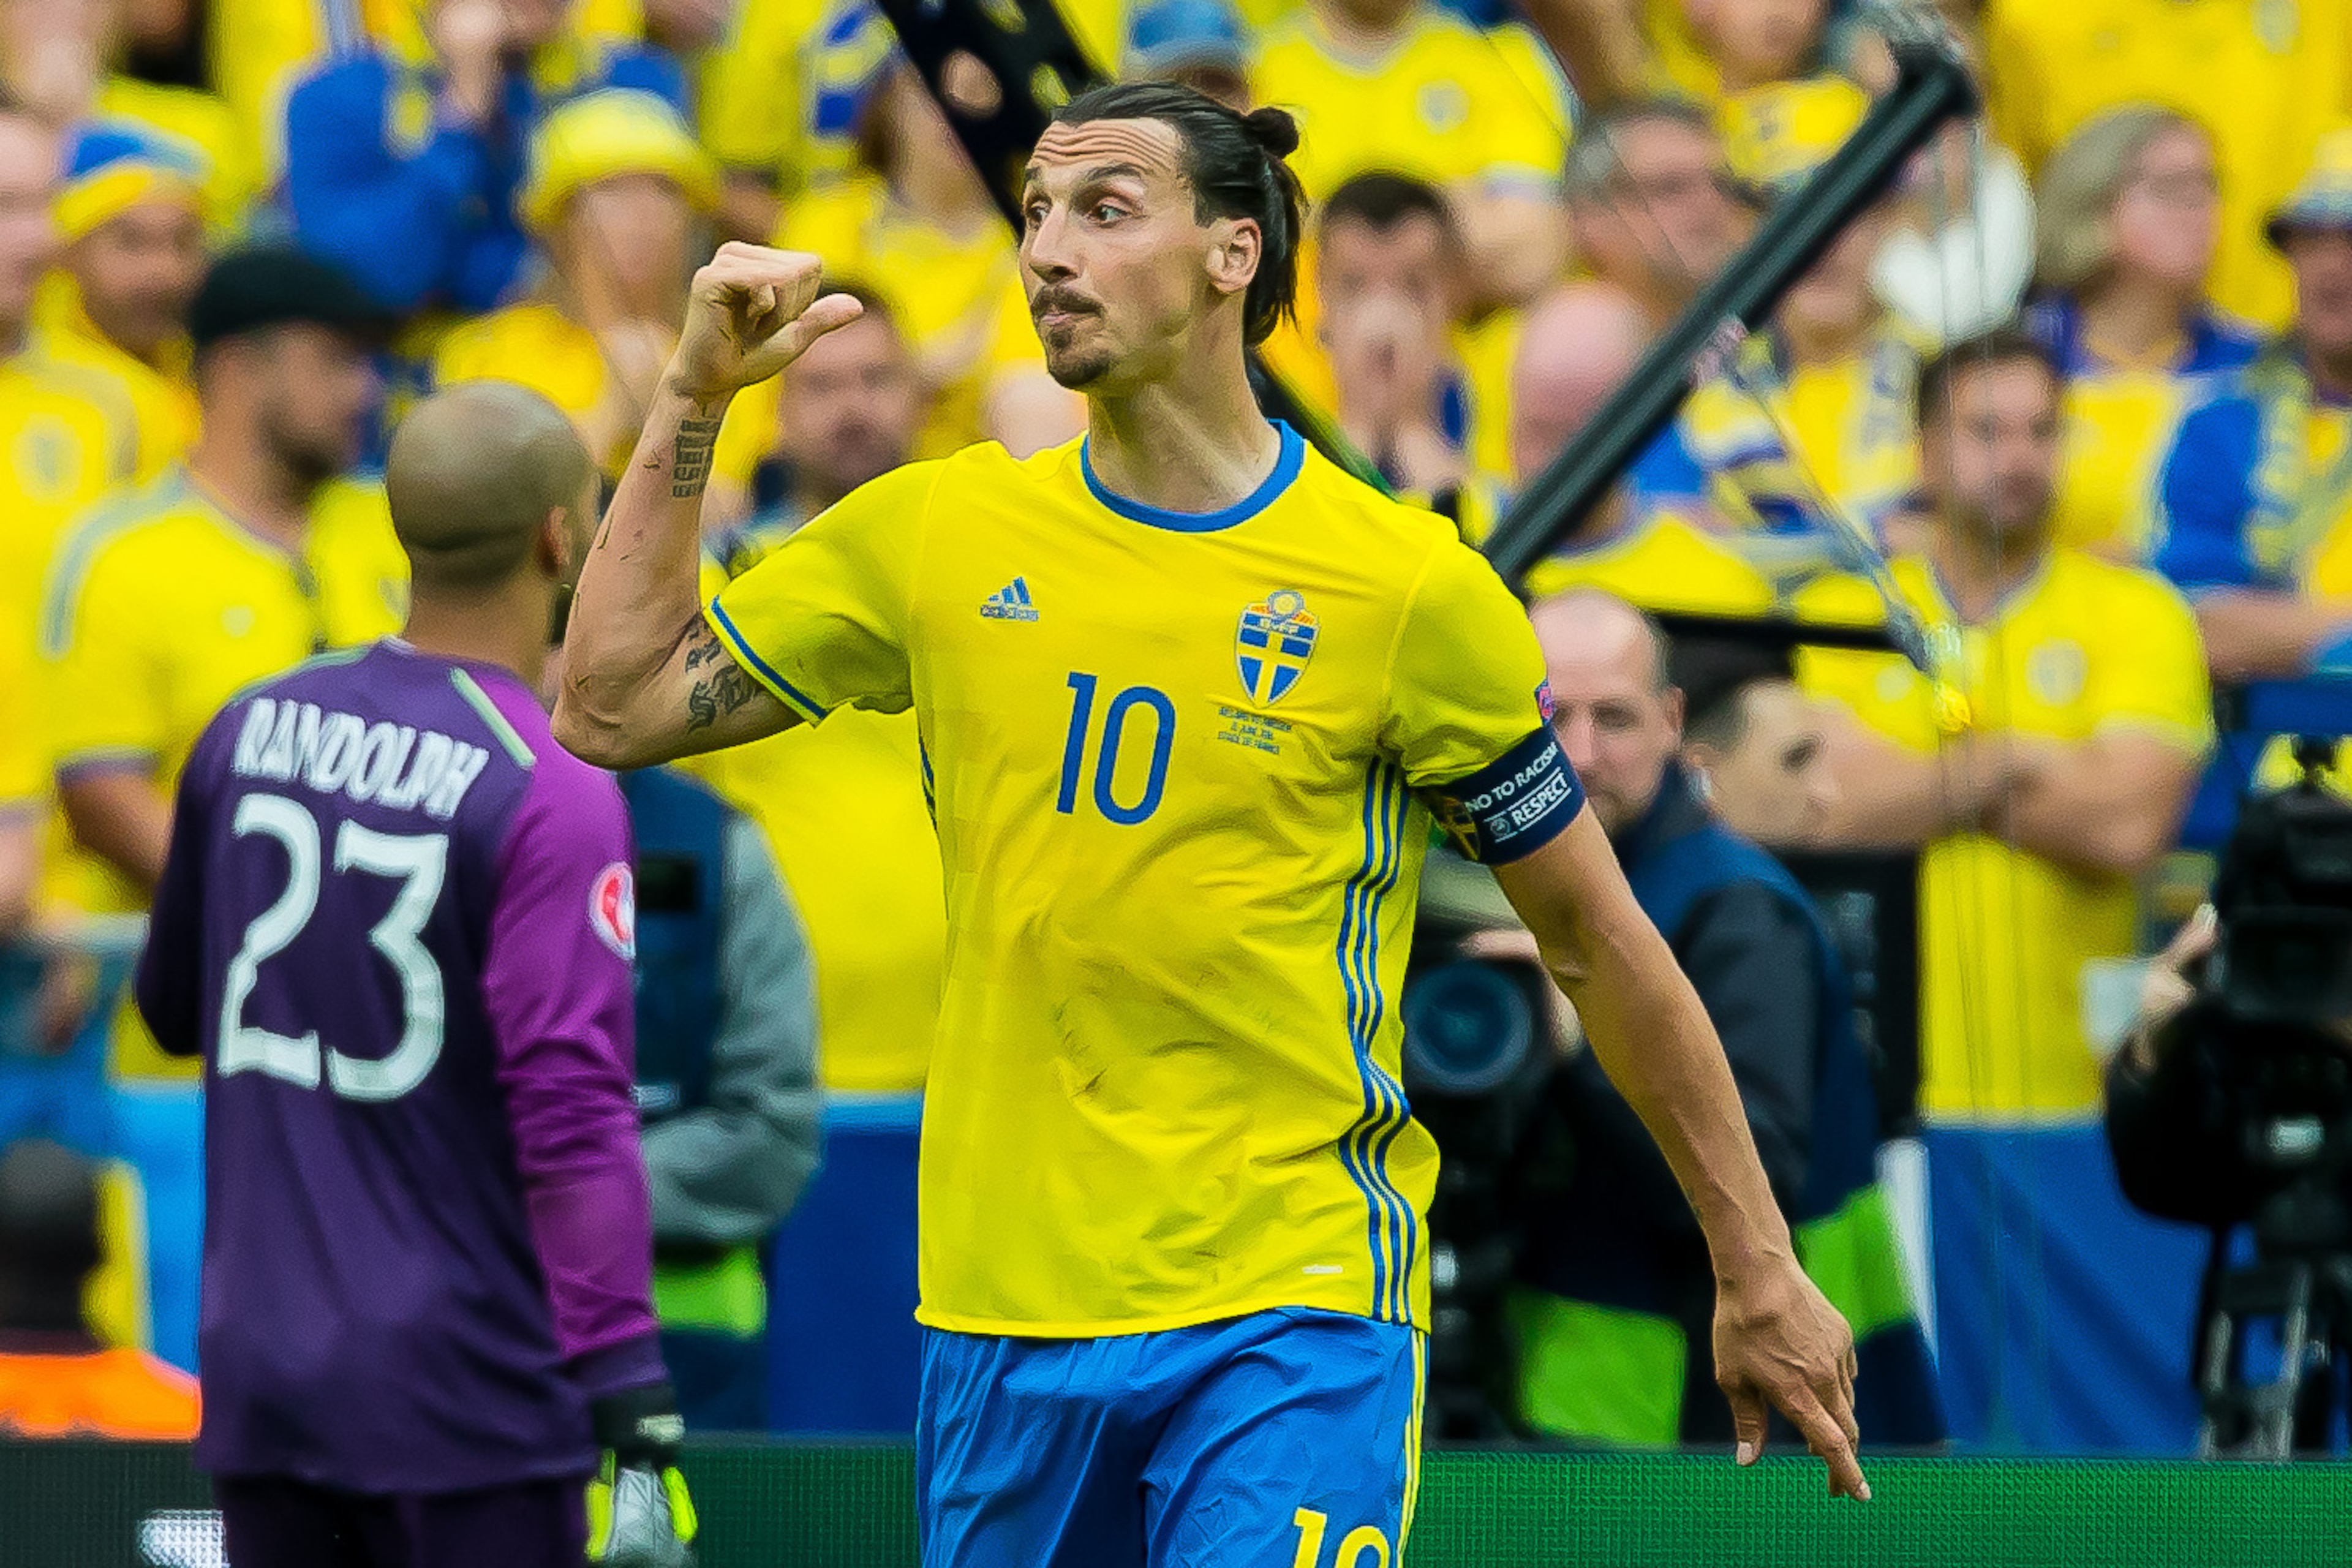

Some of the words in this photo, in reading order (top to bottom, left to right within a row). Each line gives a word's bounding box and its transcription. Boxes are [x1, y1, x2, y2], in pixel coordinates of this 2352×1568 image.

[233, 698, 489, 821] RANDOLPH
[1055, 671, 1176, 826] 10
[1465, 793, 1492, 813] NO
[1491, 780, 1515, 801] TO
[1515, 741, 1559, 787] RACISM
[1511, 772, 1568, 826] RESPECT
[217, 793, 449, 1101] 23
